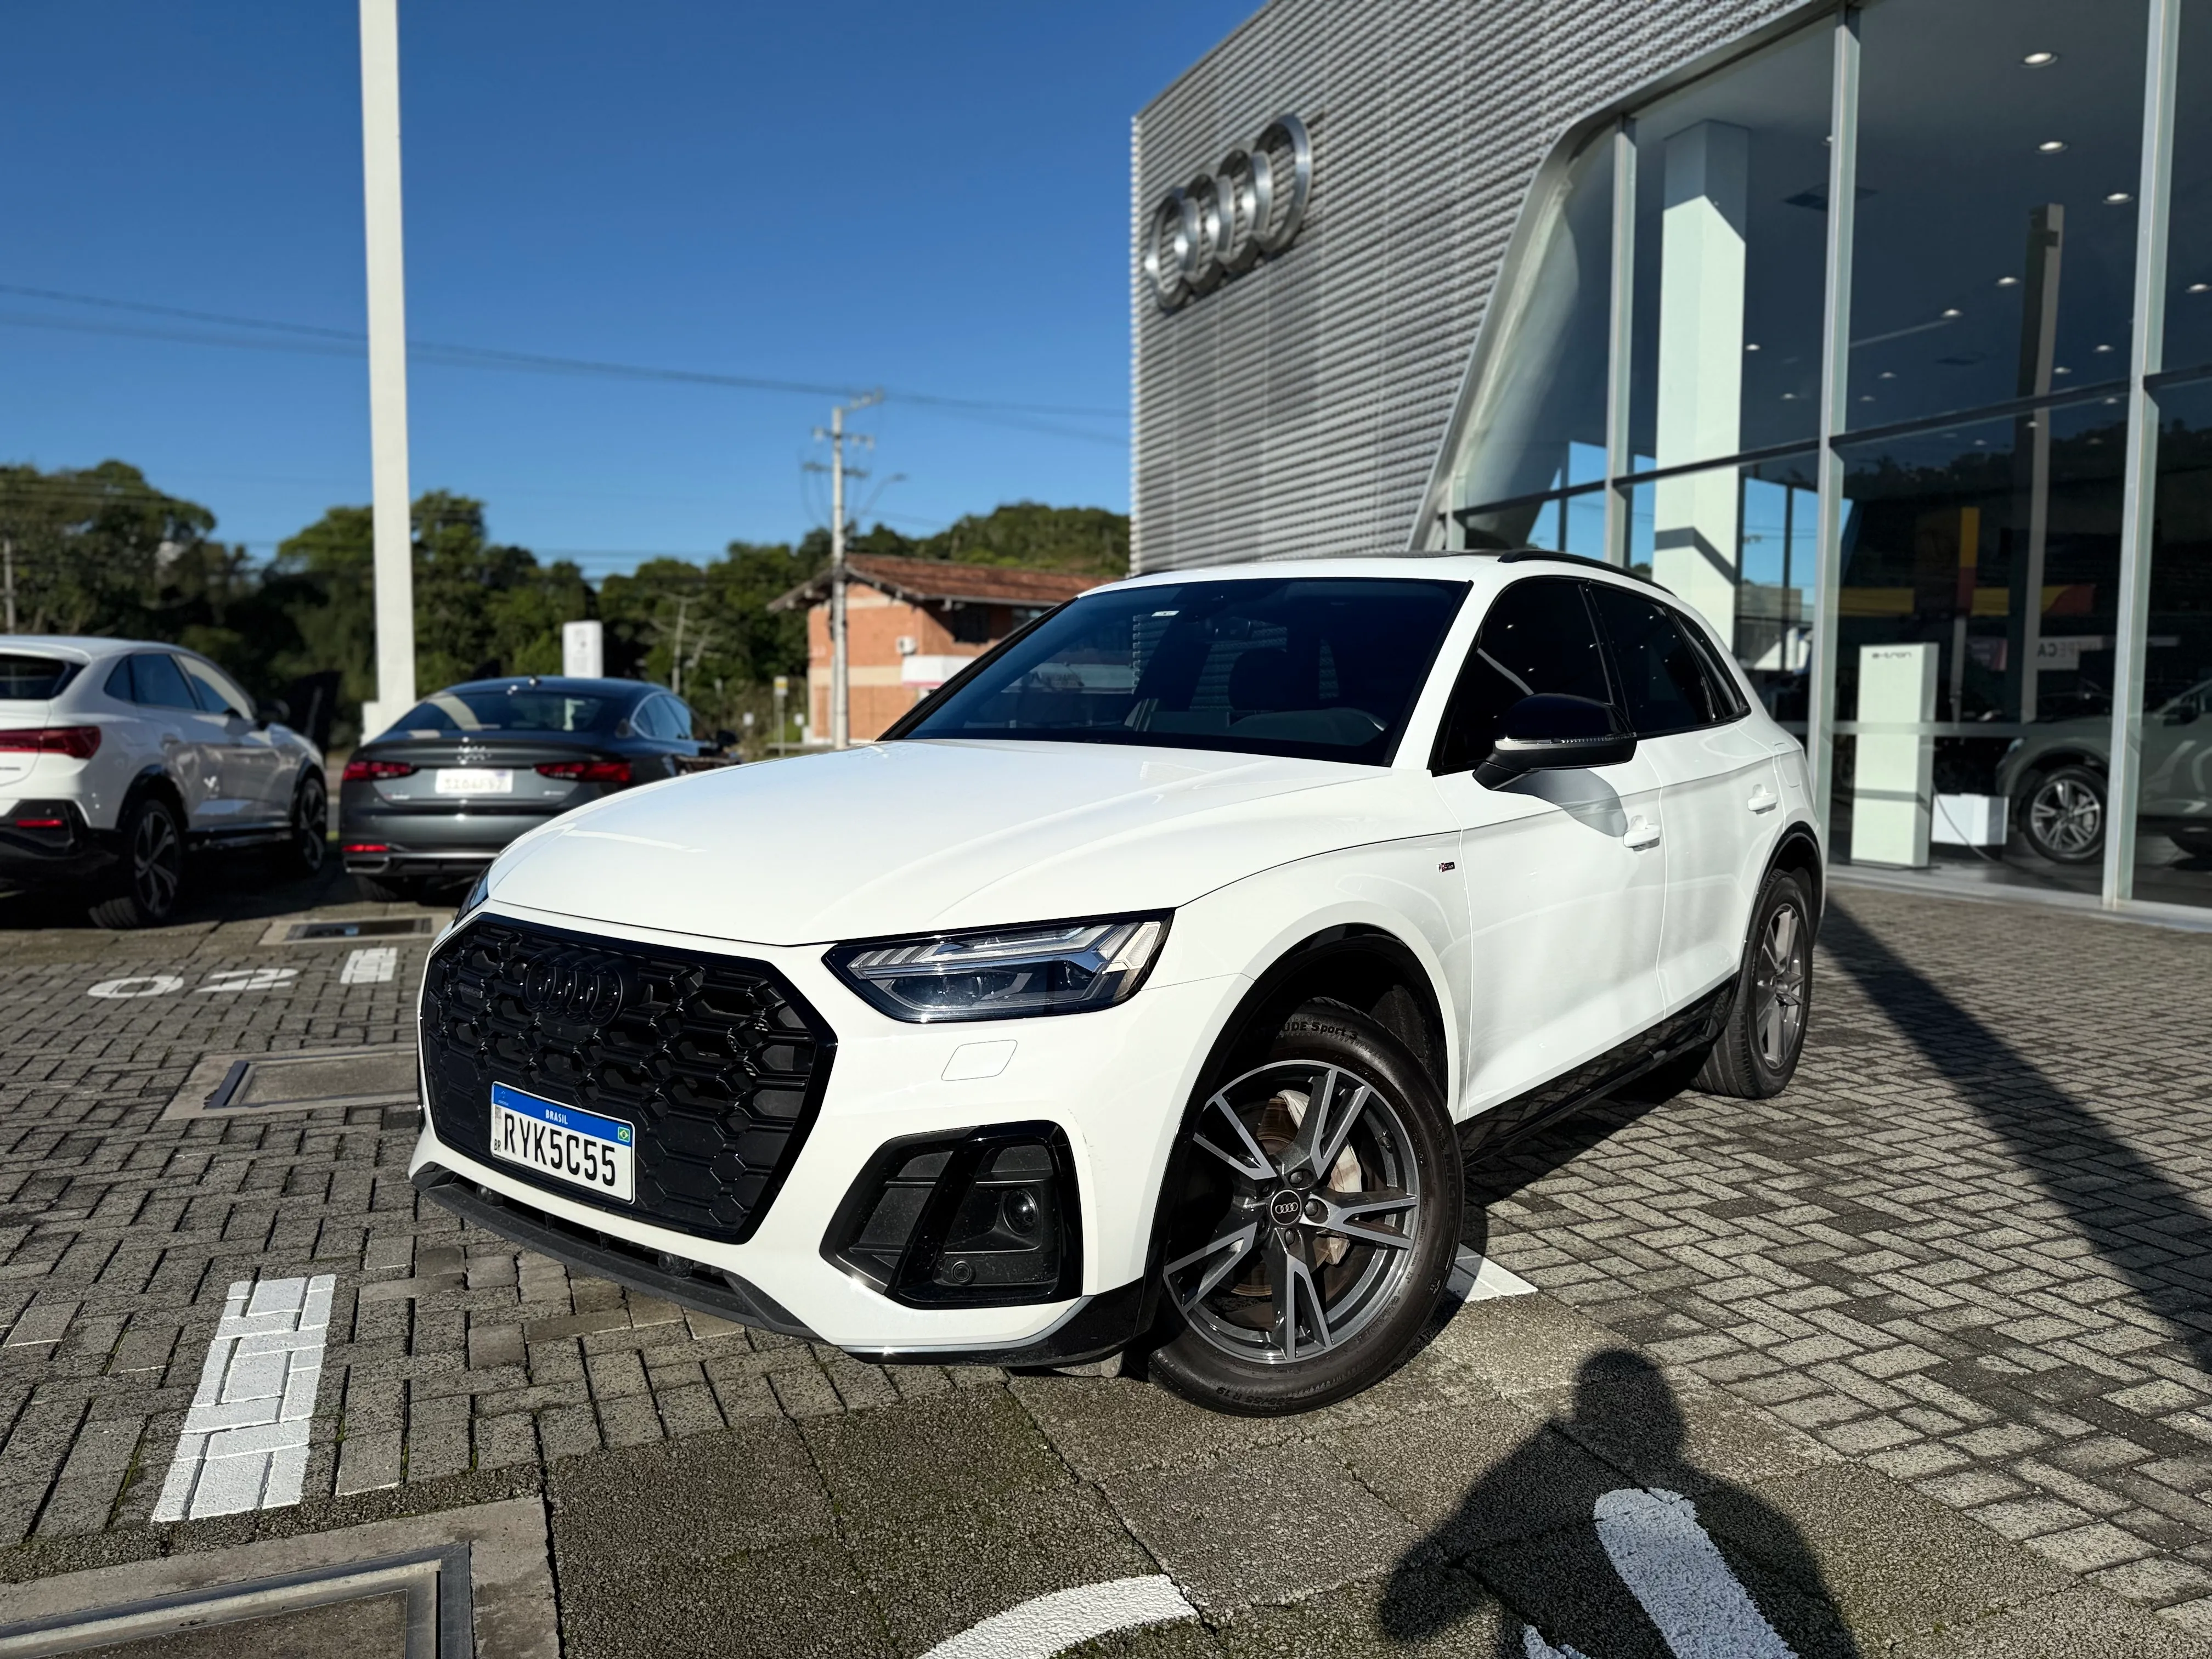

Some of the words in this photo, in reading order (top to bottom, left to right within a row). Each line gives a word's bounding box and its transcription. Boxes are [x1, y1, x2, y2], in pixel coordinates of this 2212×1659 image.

[1311, 1022, 1346, 1036] Sport
[1349, 1030, 1358, 1040] 3
[545, 1109, 568, 1125] BRASIL
[494, 1138, 501, 1153] BR
[504, 1113, 616, 1187] RYK5C55
[1216, 1387, 1230, 1397] 19
